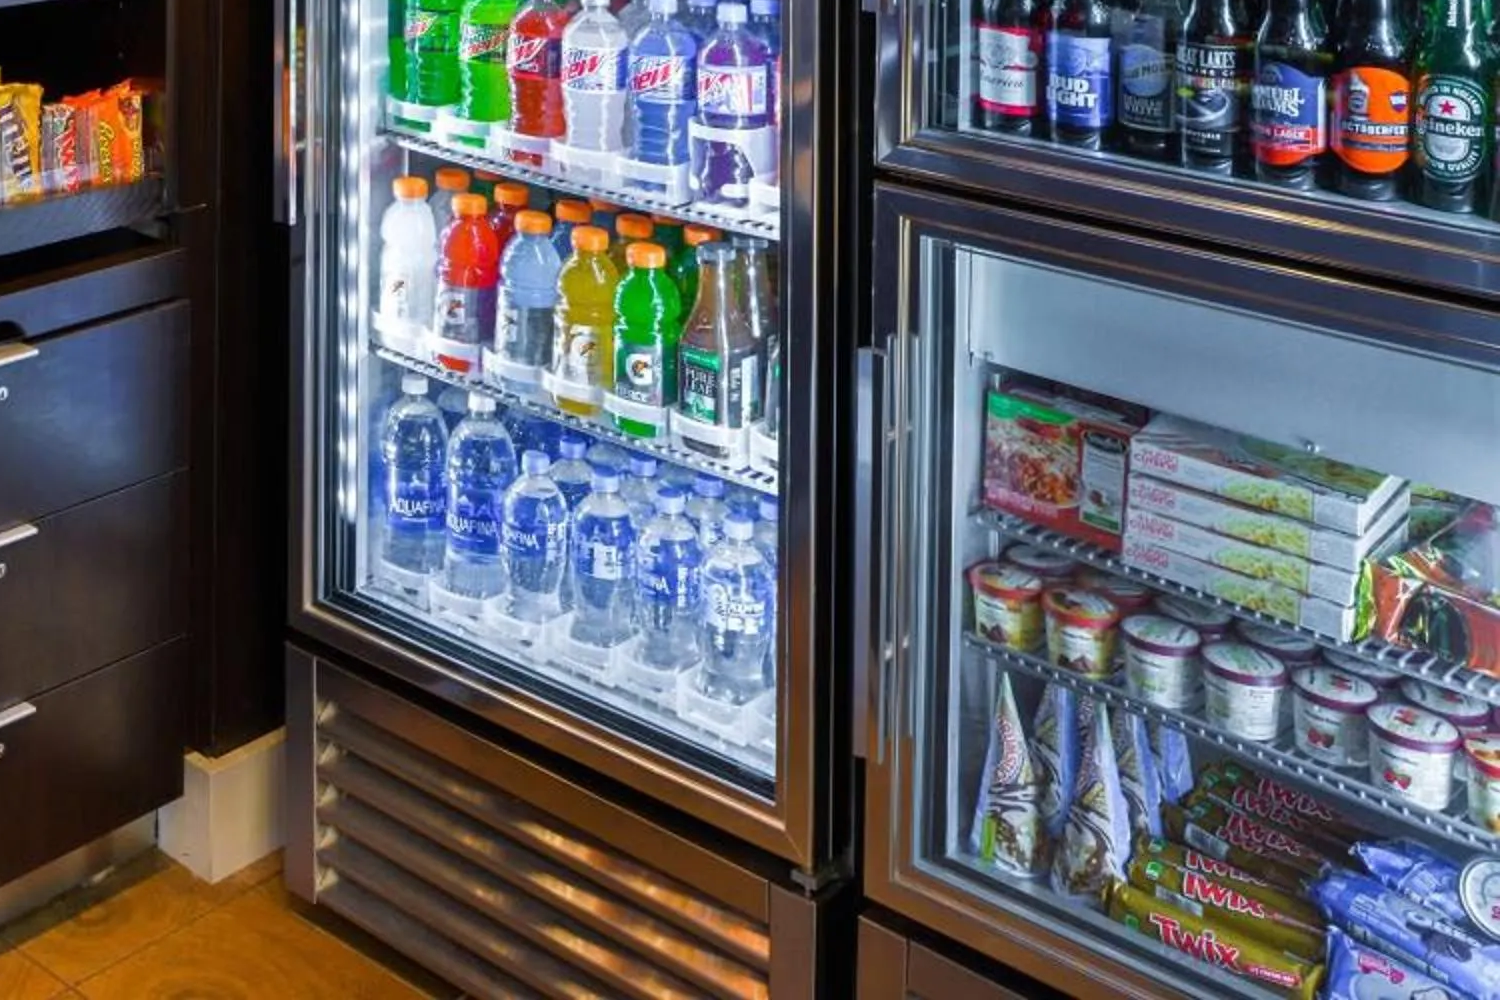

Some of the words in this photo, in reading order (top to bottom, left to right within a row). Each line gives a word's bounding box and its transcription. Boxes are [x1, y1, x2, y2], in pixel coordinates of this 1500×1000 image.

[1199, 48, 1237, 69] LAKES
[1050, 76, 1089, 93] BUD
[1253, 85, 1306, 104] MUEL
[1419, 117, 1485, 138] ineken
[389, 497, 447, 516] AQUAFINA
[1149, 911, 1241, 974] Twix
